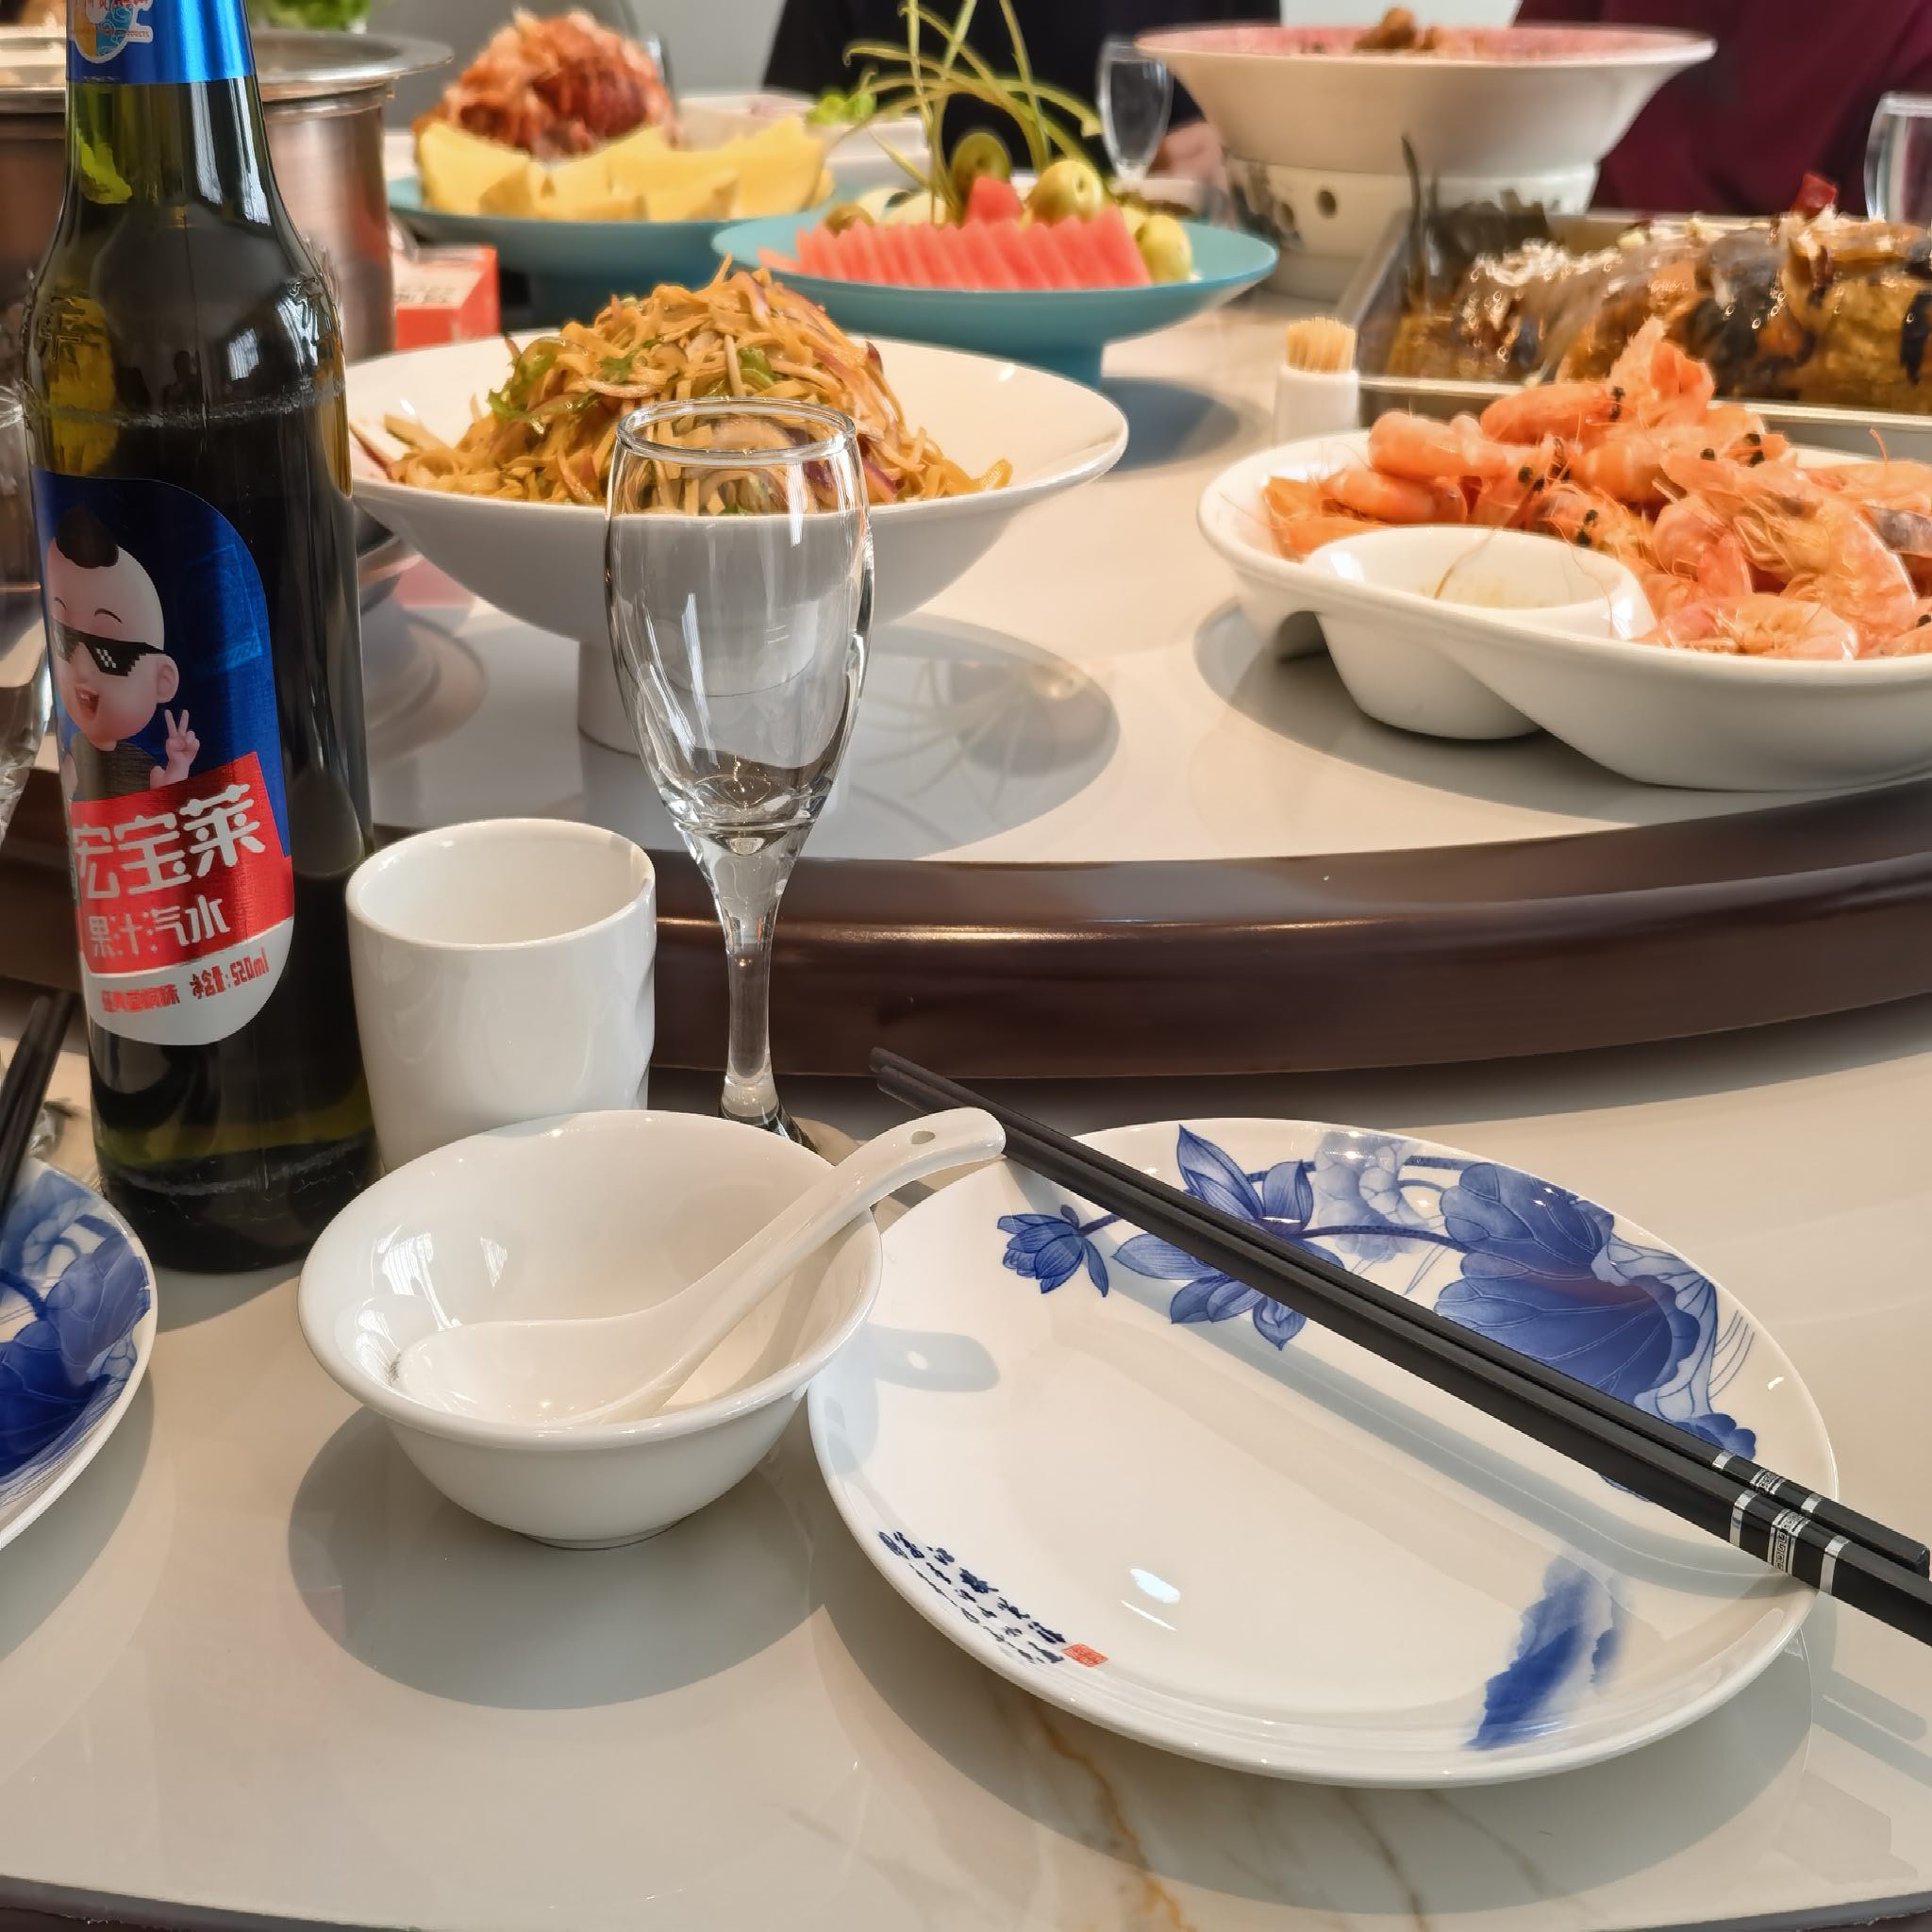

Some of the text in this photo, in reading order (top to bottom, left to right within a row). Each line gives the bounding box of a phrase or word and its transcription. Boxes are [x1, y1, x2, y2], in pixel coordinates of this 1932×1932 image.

[73, 784, 266, 899] 宏宝莱
[89, 895, 230, 958] 果汁汽水
